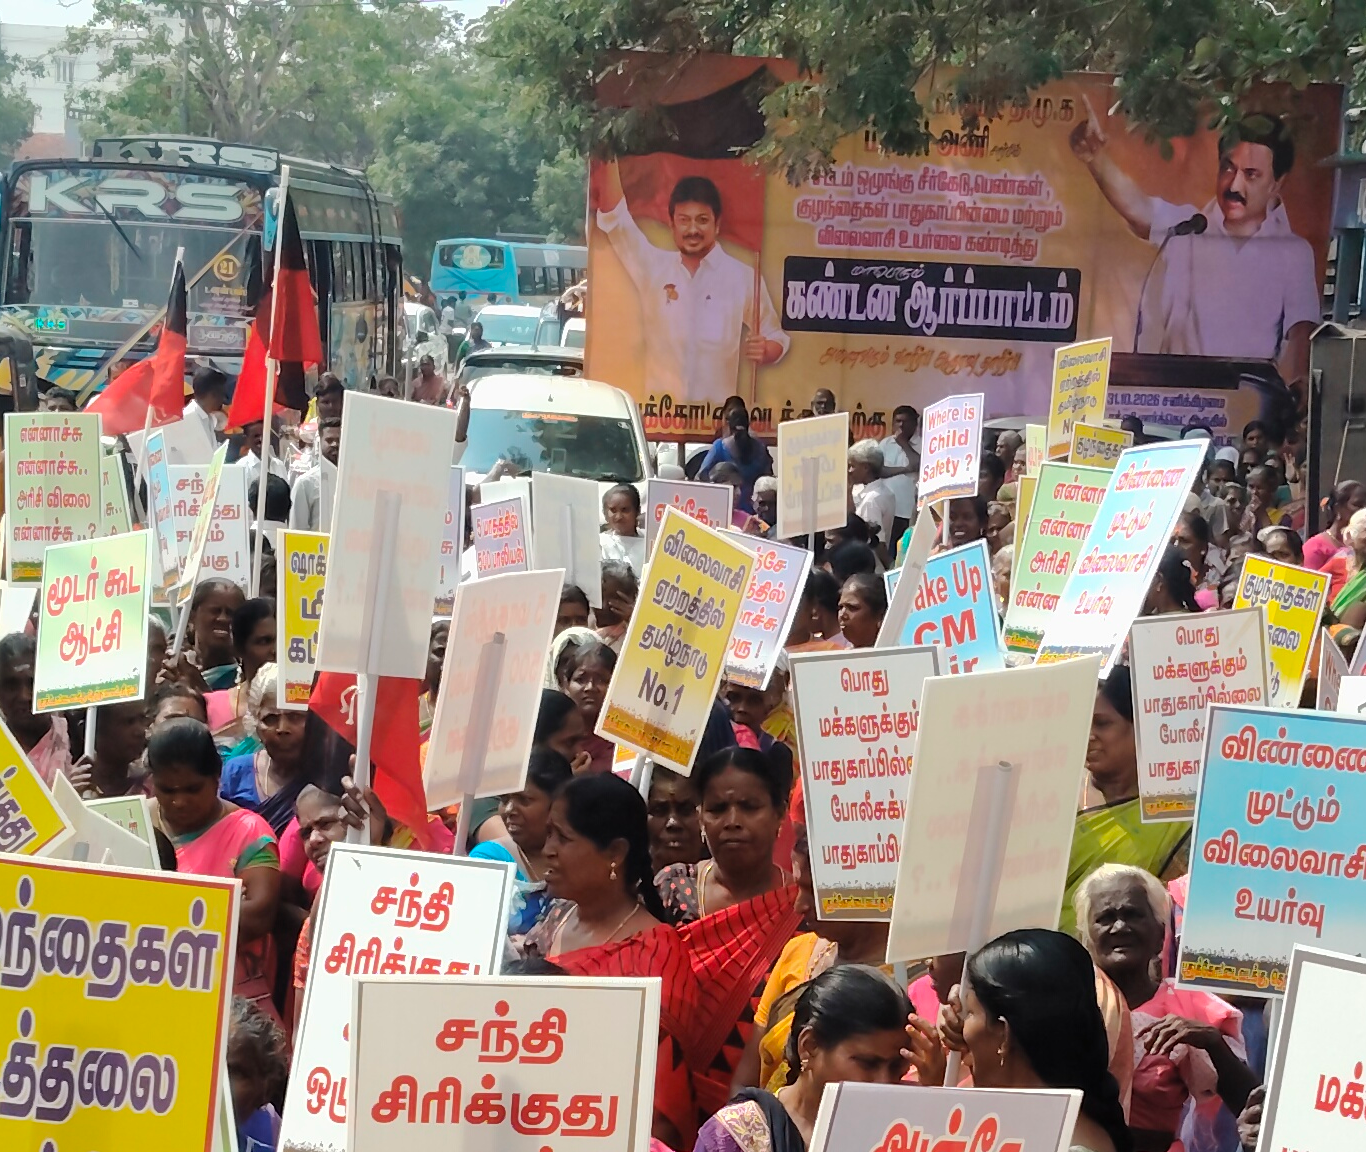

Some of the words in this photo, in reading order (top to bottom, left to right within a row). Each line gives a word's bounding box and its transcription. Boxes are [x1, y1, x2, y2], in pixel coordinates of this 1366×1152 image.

[97, 140, 277, 171] KRS
[29, 175, 247, 223] KRS
[785, 260, 900, 322] கண்டன
[904, 266, 1075, 336] ஆர்ப்பாட்டம்
[19, 421, 83, 444] என்னாச்சு
[927, 407, 959, 430] Where
[962, 405, 975, 422] is
[928, 427, 970, 453] Child
[922, 459, 959, 484] Safety
[46, 485, 91, 509] விலை
[663, 529, 745, 594] விலைவாசி
[954, 560, 983, 599] Up
[46, 557, 99, 617] மூடர்
[103, 566, 140, 598] கூட
[652, 575, 726, 631] ஏற்றத்தில்
[1242, 569, 1320, 615] குழந்தைகள்
[59, 609, 122, 666] ஆட்சி
[913, 607, 977, 648] CM
[1175, 625, 1221, 649] பொது
[638, 623, 708, 680] தமிழ்நாடு
[1152, 647, 1248, 684] மக்களுக்கும்
[637, 667, 686, 717] No.1
[841, 666, 891, 695] பொது
[1144, 682, 1263, 718] பாதுகாப்பில்லை
[1246, 783, 1341, 832] முட்டும்
[369, 872, 454, 932] சந்தி
[1234, 888, 1326, 939] உயர்வு
[435, 1000, 568, 1065] சந்தி
[370, 1073, 620, 1138] சிரிக்குது
